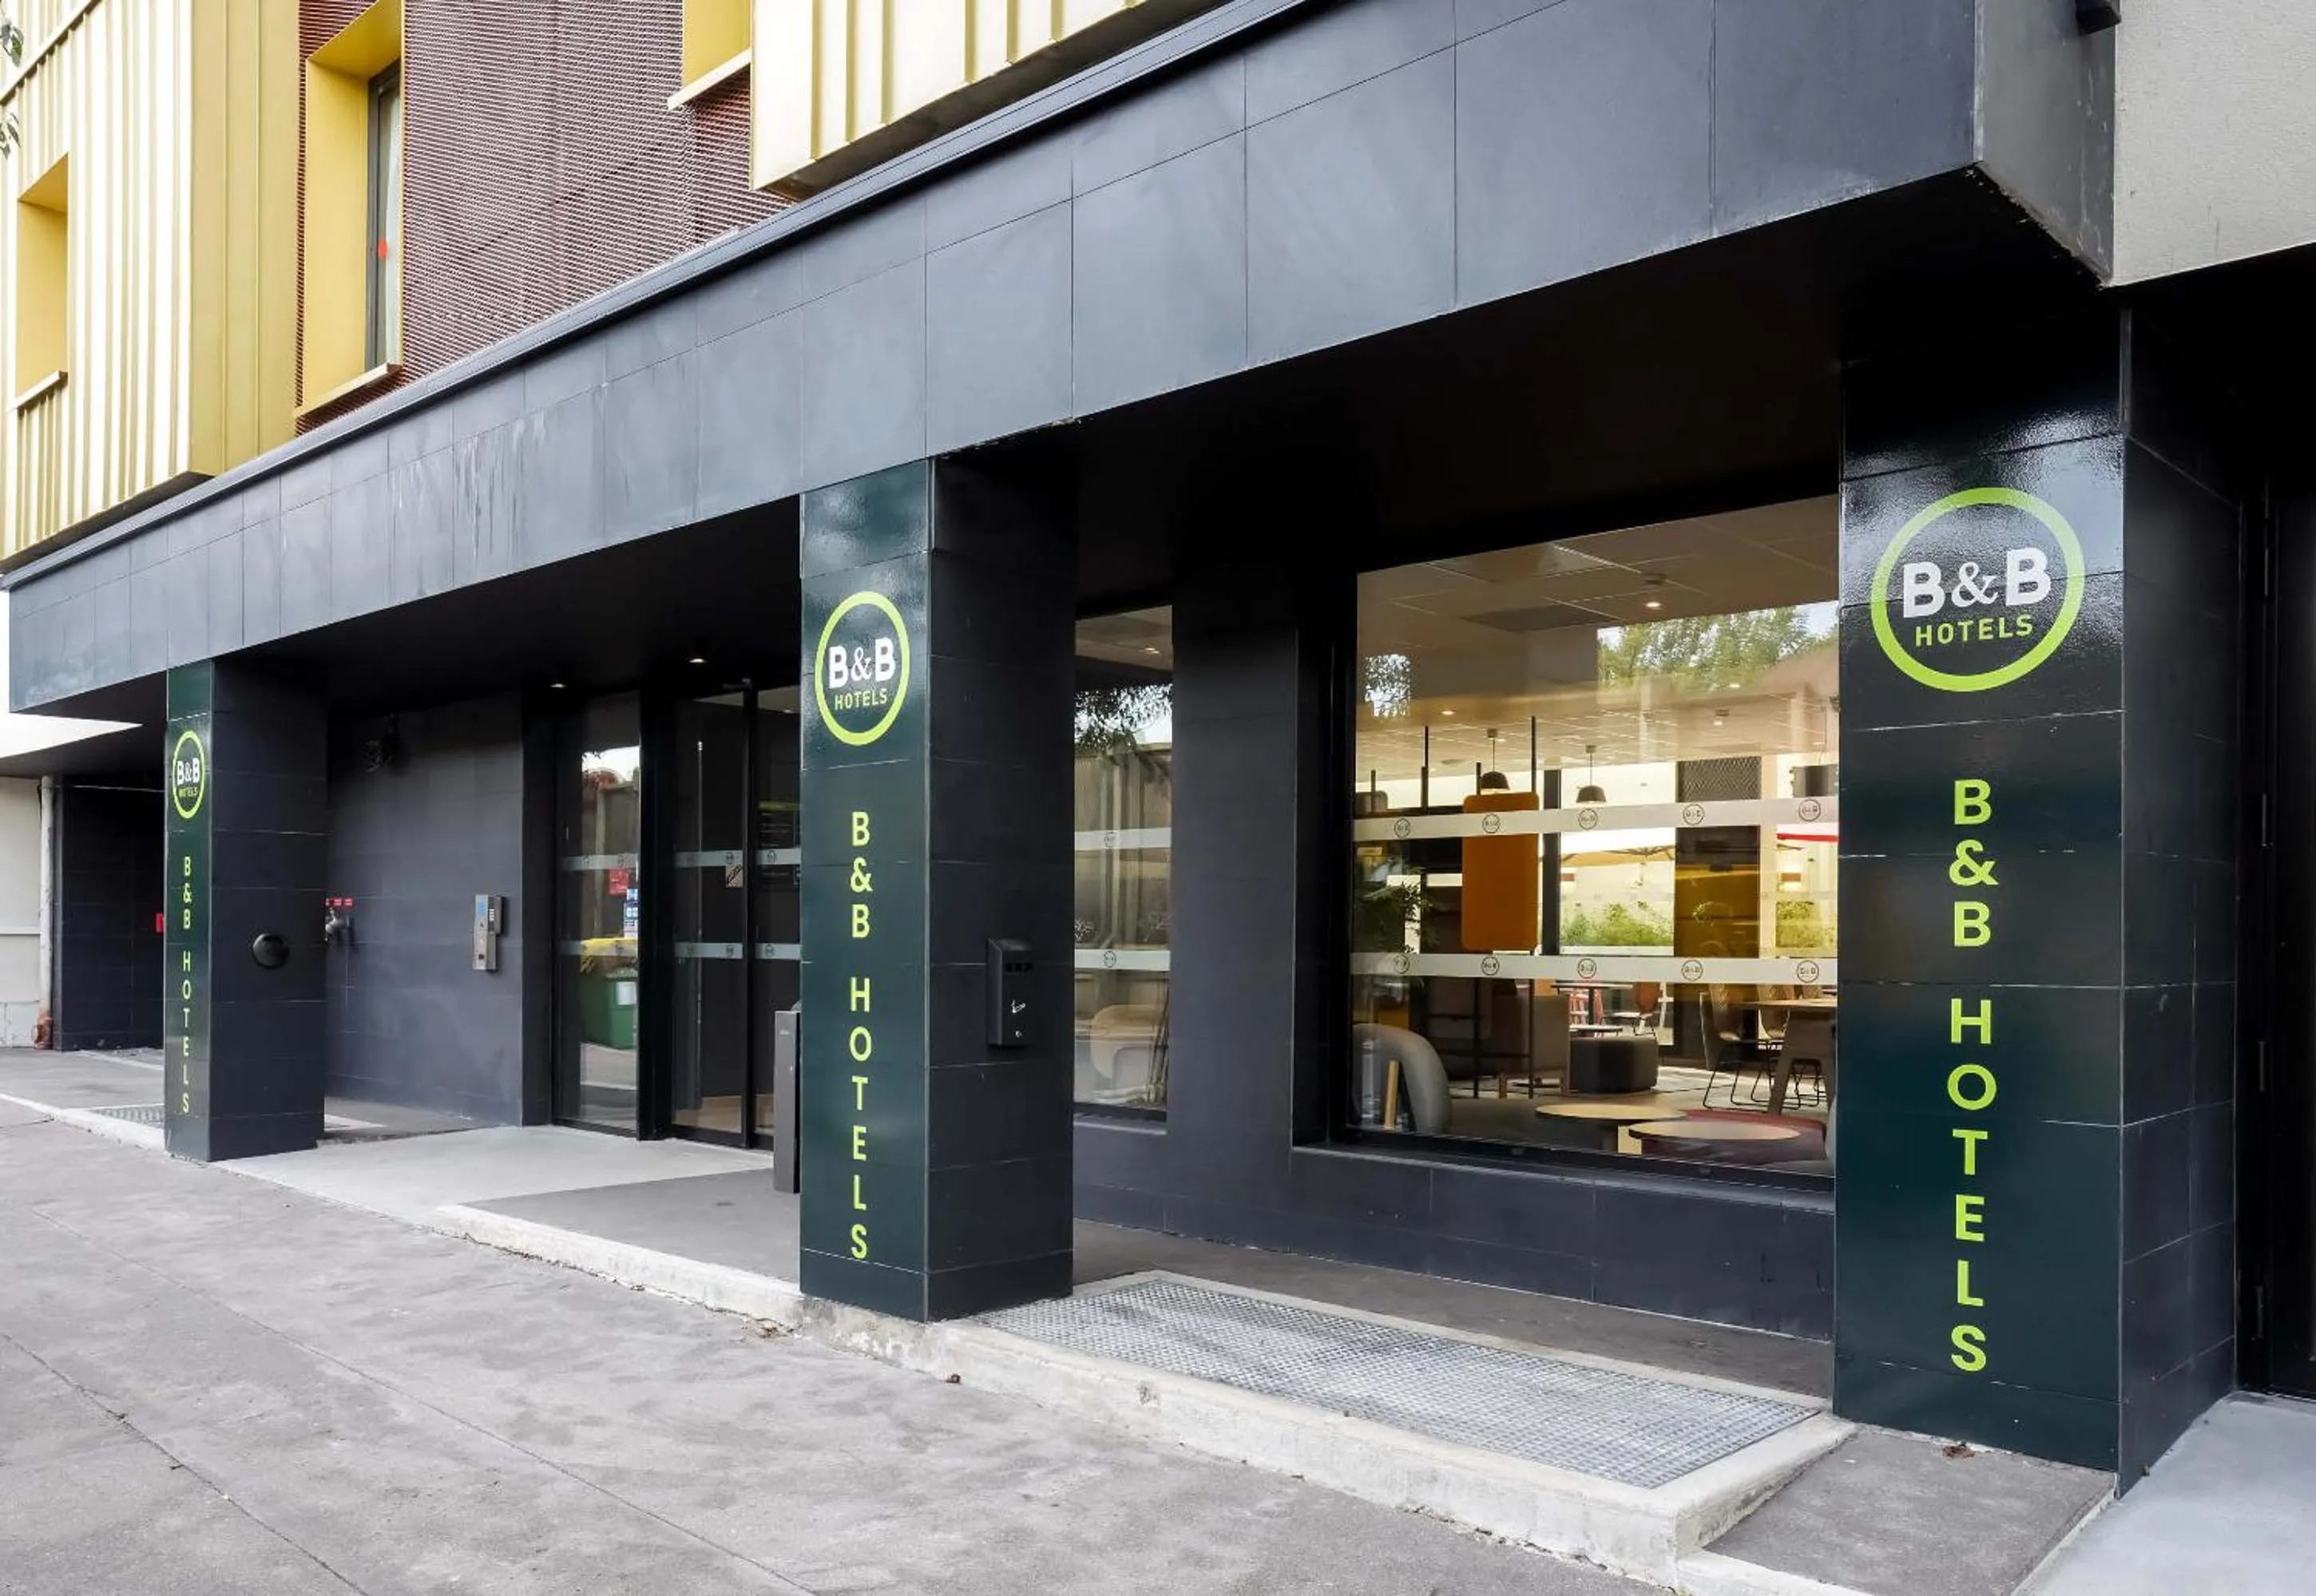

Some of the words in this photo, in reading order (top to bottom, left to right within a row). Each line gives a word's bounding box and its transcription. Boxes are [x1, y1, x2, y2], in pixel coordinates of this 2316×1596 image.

[1903, 548, 2051, 618] B&B
[829, 637, 895, 689] B&B
[1915, 613, 2033, 647] HOTELS
[835, 687, 888, 711] HOTELS
[177, 758, 200, 785] B&B
[183, 856, 192, 929] B&B
[850, 811, 874, 940] B&B
[1948, 779, 1998, 948] B&B
[182, 950, 191, 1113] HOTELS
[849, 976, 873, 1260] HOTELS
[1947, 997, 1997, 1372] HOTELS
